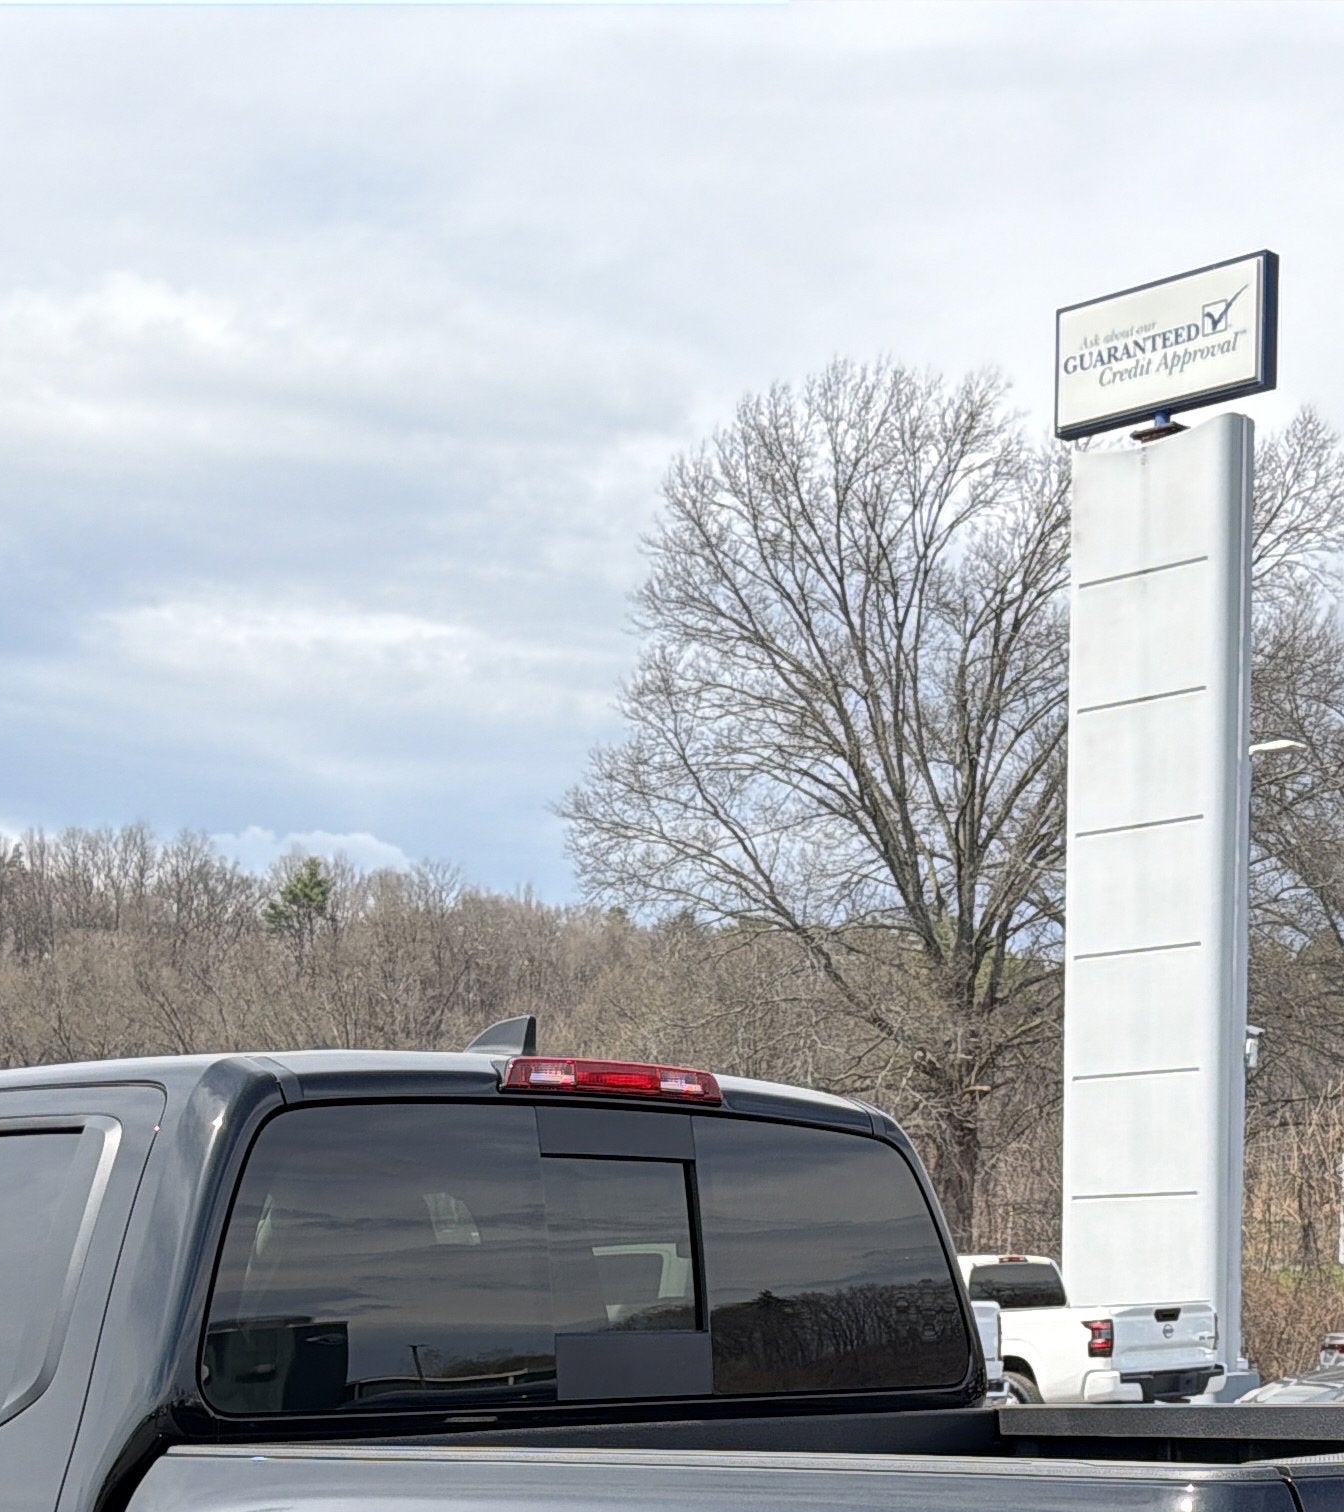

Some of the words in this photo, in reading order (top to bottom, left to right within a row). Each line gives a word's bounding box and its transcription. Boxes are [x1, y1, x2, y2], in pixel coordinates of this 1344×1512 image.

[1063, 322, 1200, 375] GUARANTEED
[1080, 336, 1100, 351] Ask
[1102, 326, 1135, 344] about
[1136, 321, 1158, 336] our
[1098, 355, 1153, 387] Credit
